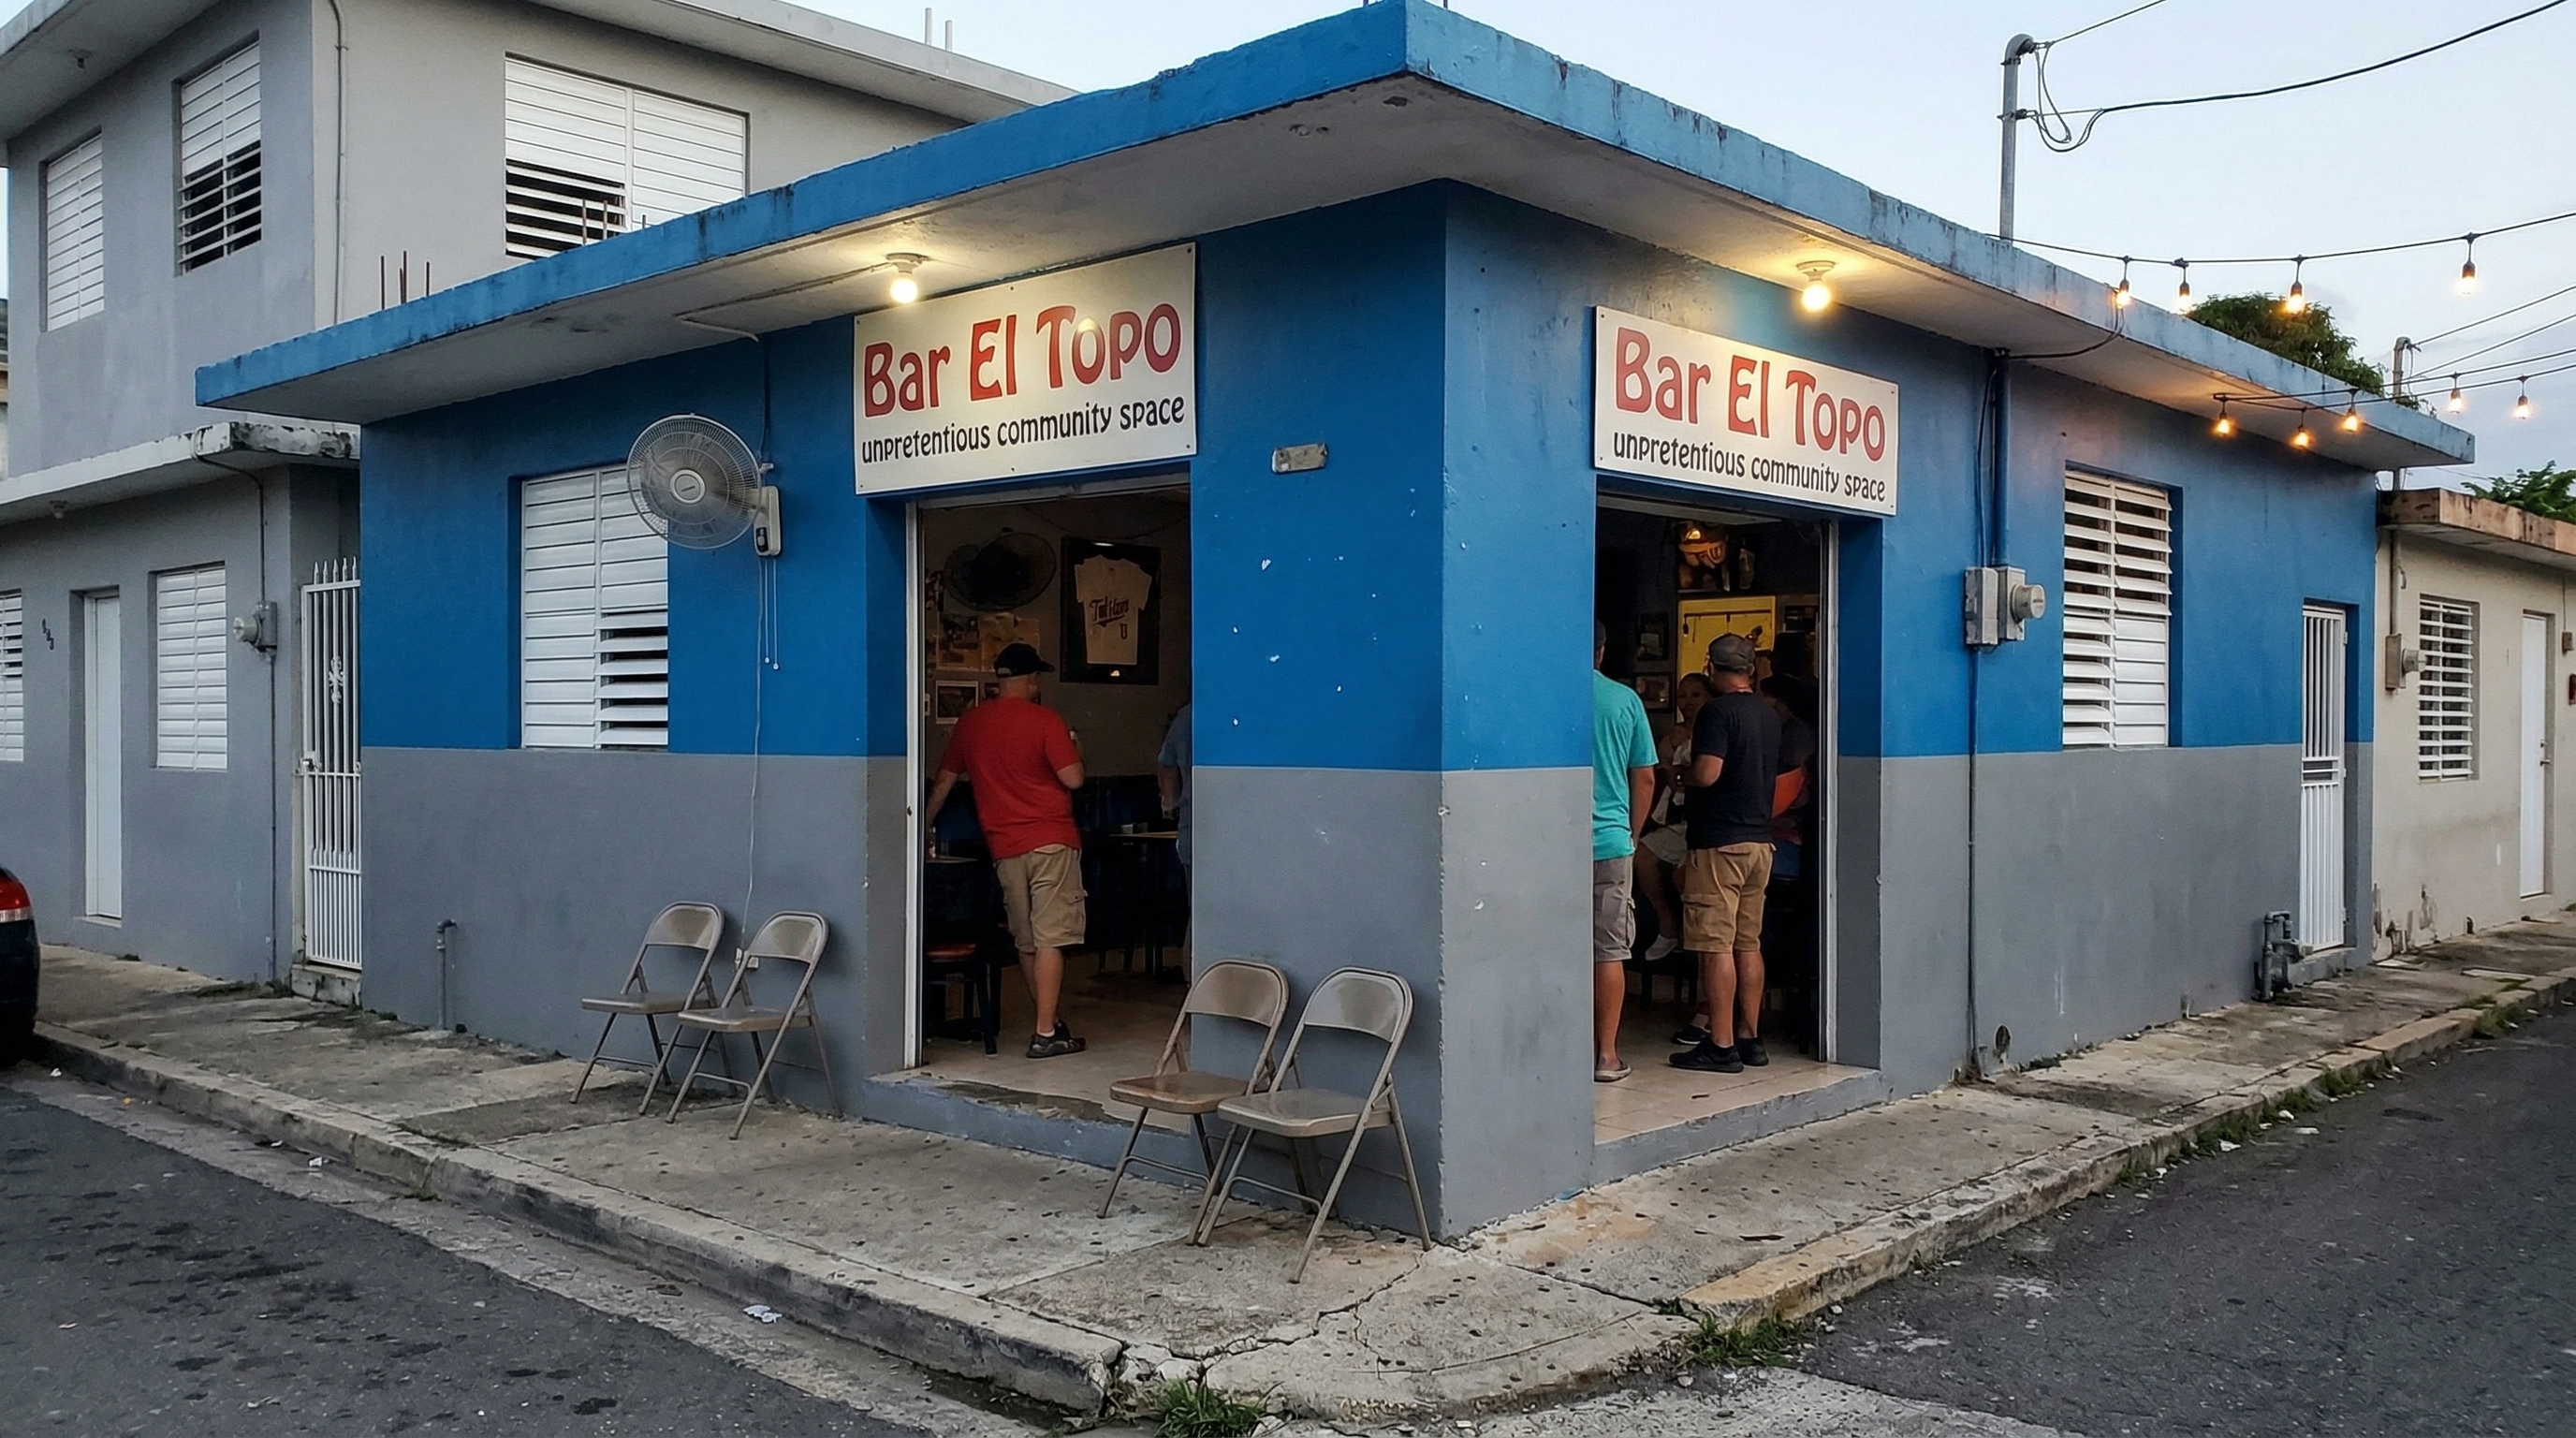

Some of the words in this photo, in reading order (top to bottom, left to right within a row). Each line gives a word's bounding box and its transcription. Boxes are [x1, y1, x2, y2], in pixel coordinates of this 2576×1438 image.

[863, 341, 951, 418] Bar
[969, 314, 1018, 402] El
[1615, 327, 1711, 424] Bar
[1728, 355, 1771, 439] El
[861, 422, 991, 464] unpretentious
[997, 402, 1112, 447] community
[1120, 396, 1185, 431] space
[1613, 432, 1746, 477] unpretentious
[1751, 457, 1840, 494] community
[1844, 475, 1886, 503] space
